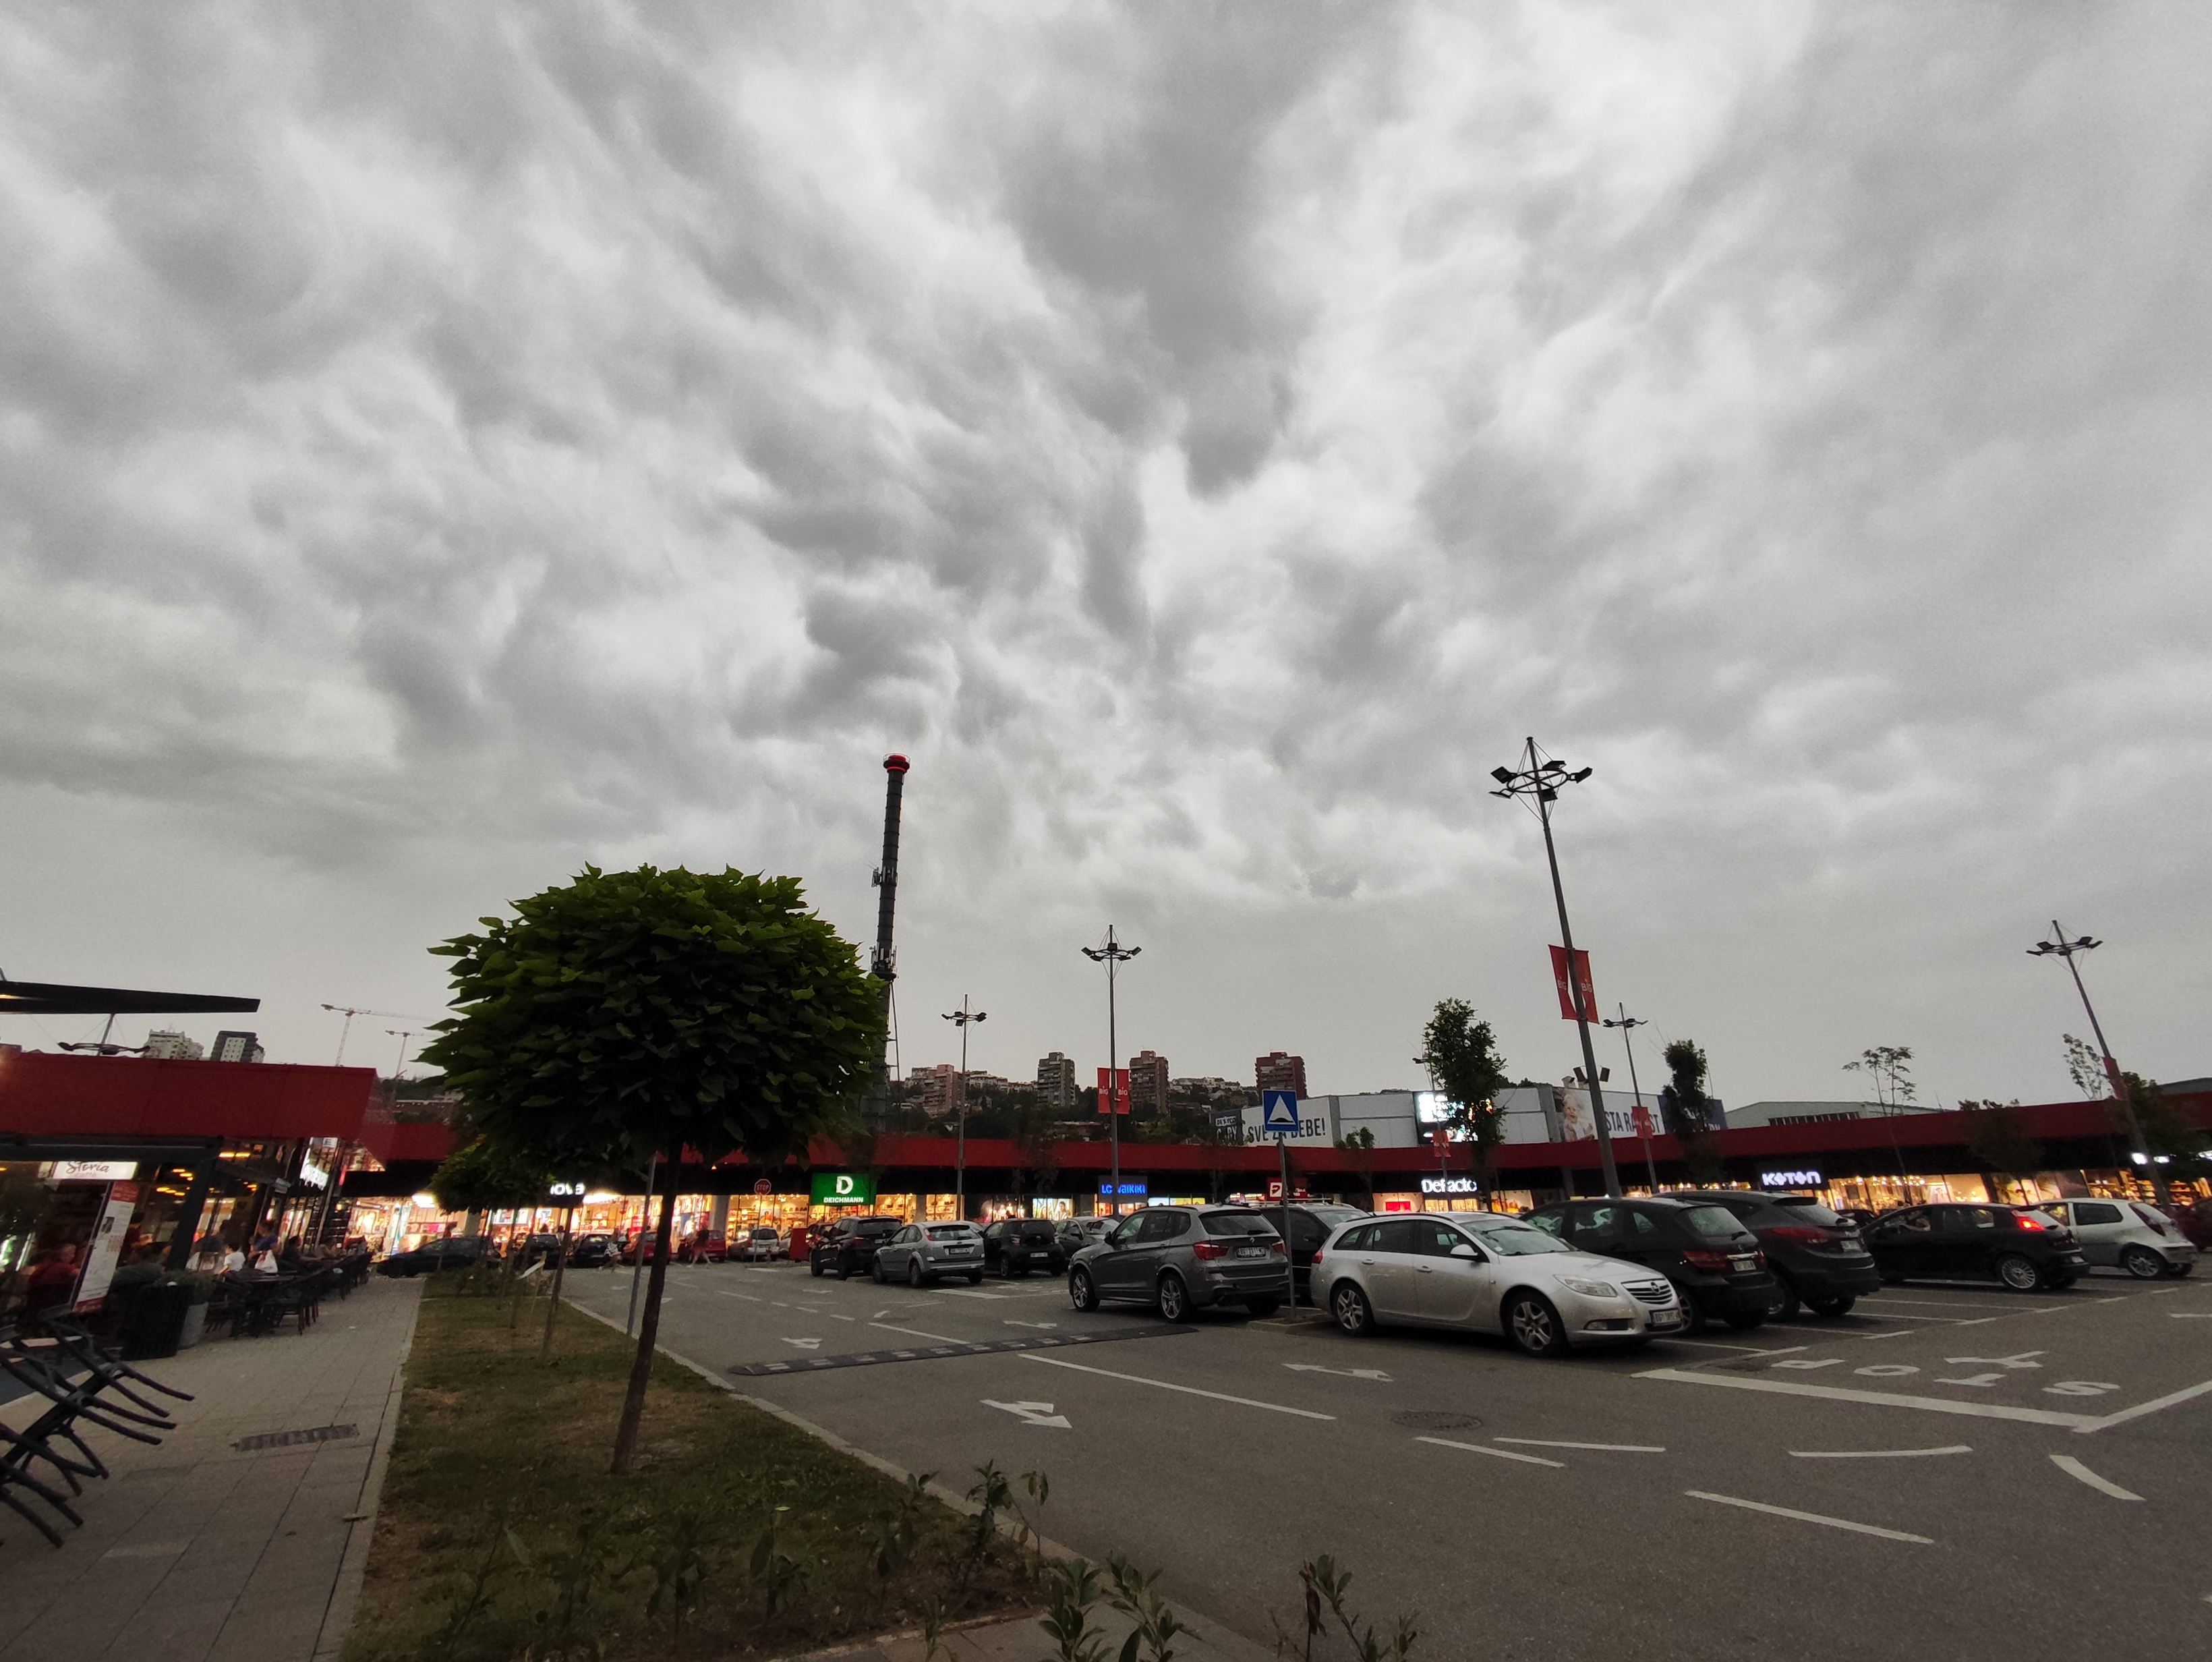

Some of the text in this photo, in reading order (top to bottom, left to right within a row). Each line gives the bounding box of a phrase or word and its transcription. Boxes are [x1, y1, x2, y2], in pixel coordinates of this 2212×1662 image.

[1248, 1124, 1269, 1143] SVE
[66, 1162, 110, 1174] Storia
[1101, 1184, 1146, 1194] LC aikiki
